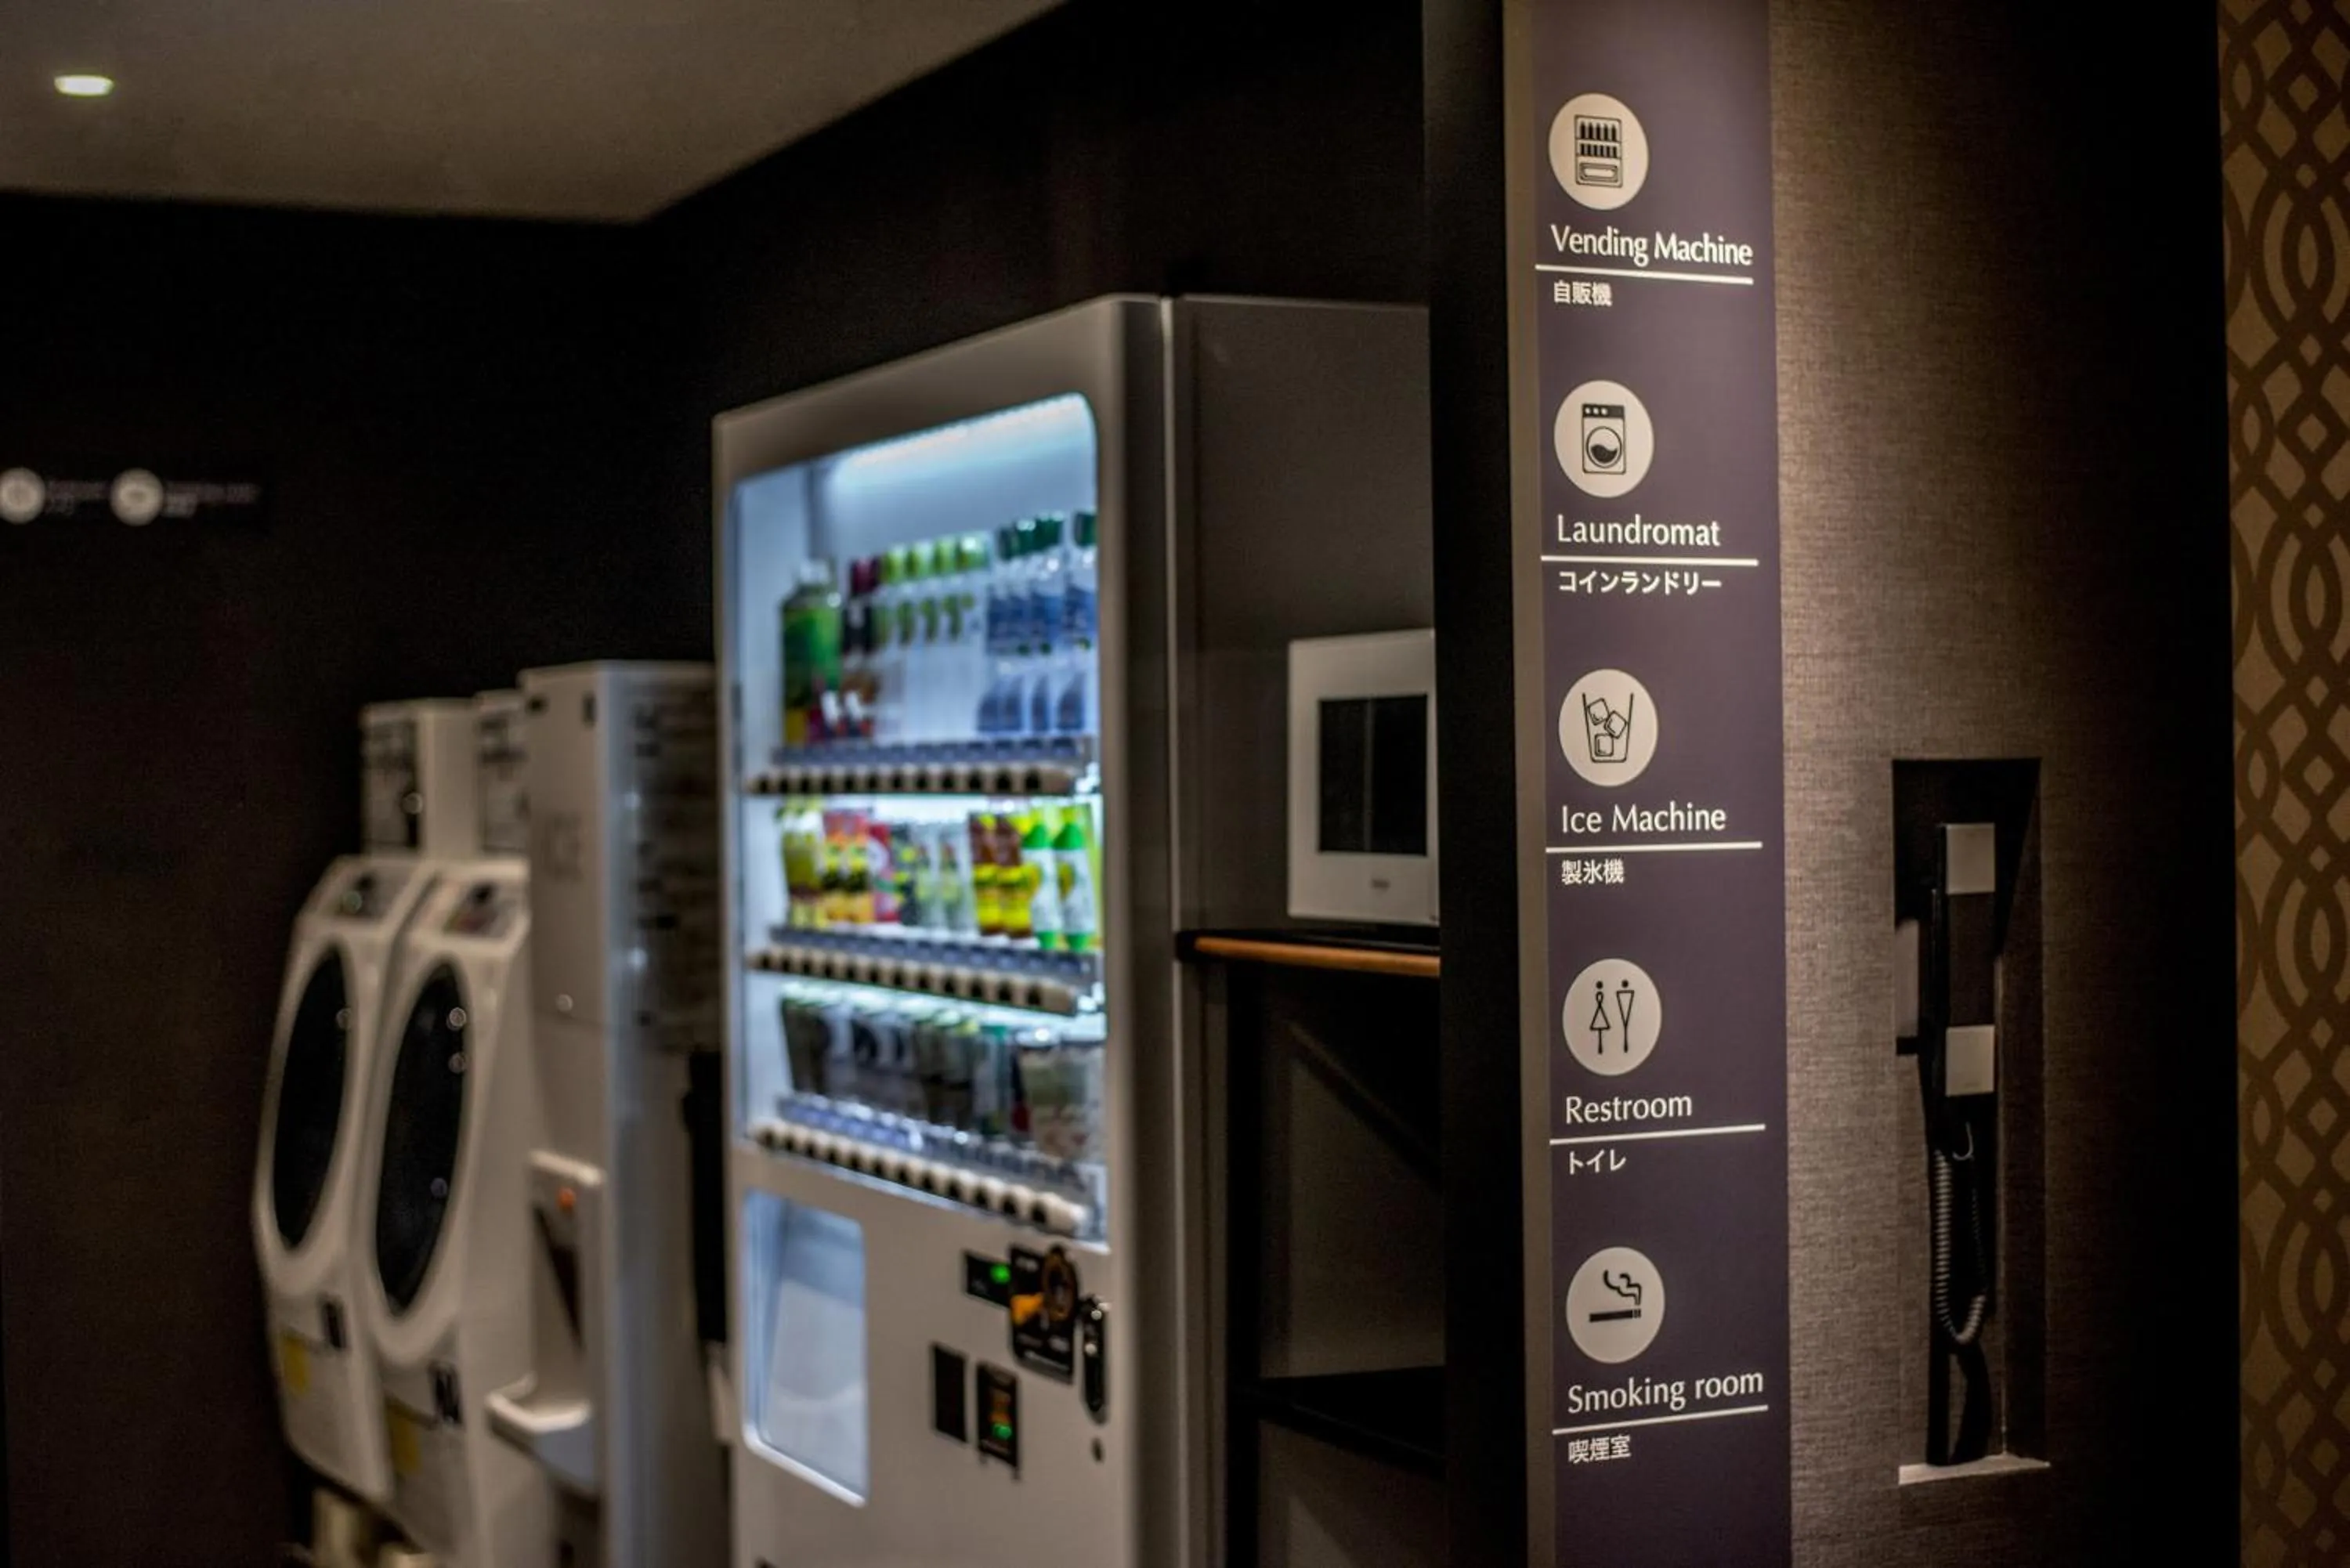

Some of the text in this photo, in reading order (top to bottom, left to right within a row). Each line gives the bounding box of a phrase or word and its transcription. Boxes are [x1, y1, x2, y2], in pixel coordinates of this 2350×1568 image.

[1550, 224, 1754, 268] Vending Machine
[1553, 279, 1614, 307] 自販機
[1557, 513, 1722, 547] Laundromat
[1559, 569, 1723, 596] コインランドリー
[1561, 800, 1727, 833] Ice Machine
[1561, 858, 1625, 886] 製氷機
[1565, 1094, 1693, 1124] Restroom
[1569, 1148, 1627, 1175] トイレ
[1567, 1372, 1764, 1414] Smoking room
[1568, 1435, 1632, 1464] 喫煙室
